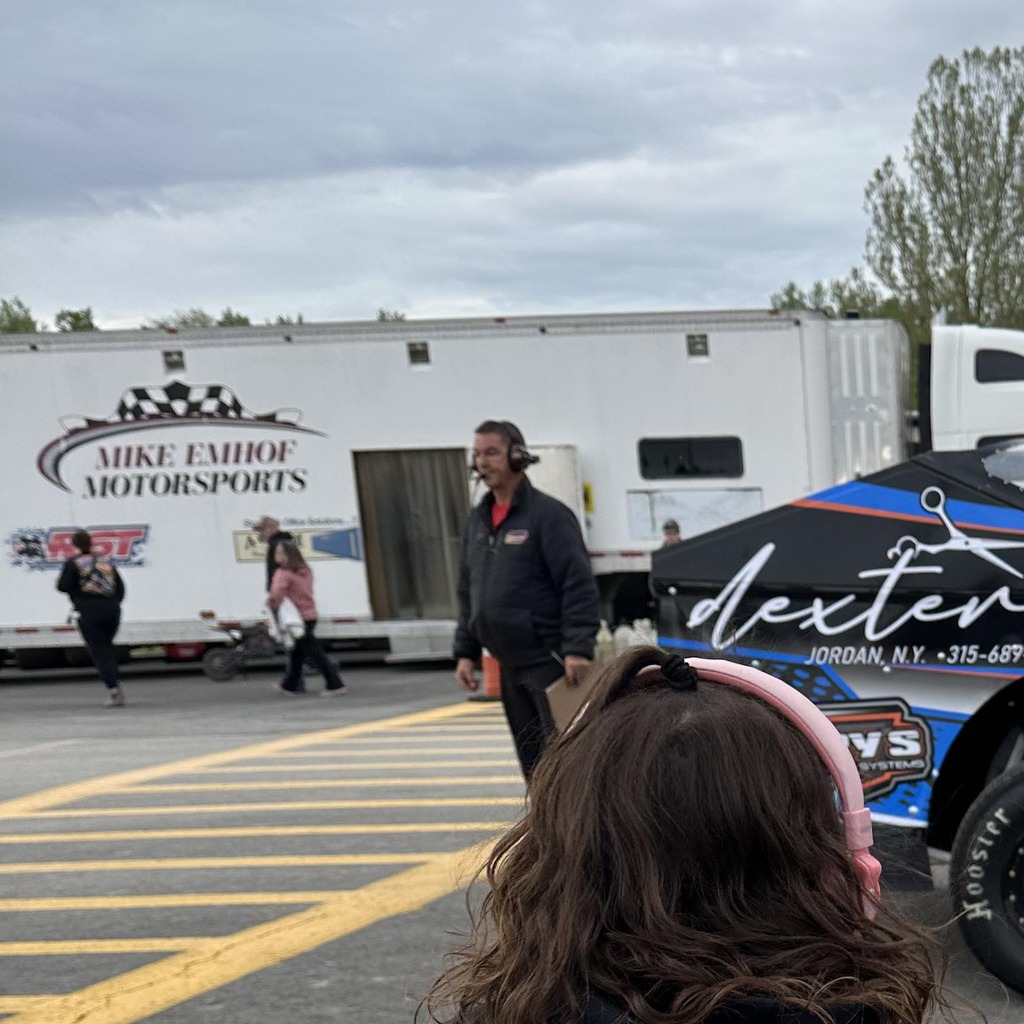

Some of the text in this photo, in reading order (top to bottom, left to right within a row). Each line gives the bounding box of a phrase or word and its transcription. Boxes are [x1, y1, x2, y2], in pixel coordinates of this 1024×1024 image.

[97, 439, 298, 470] MIKE EMHOF
[82, 468, 309, 500] MOTORSPORTS
[803, 646, 887, 666] JORDAN,
[892, 645, 926, 664] N.Y.
